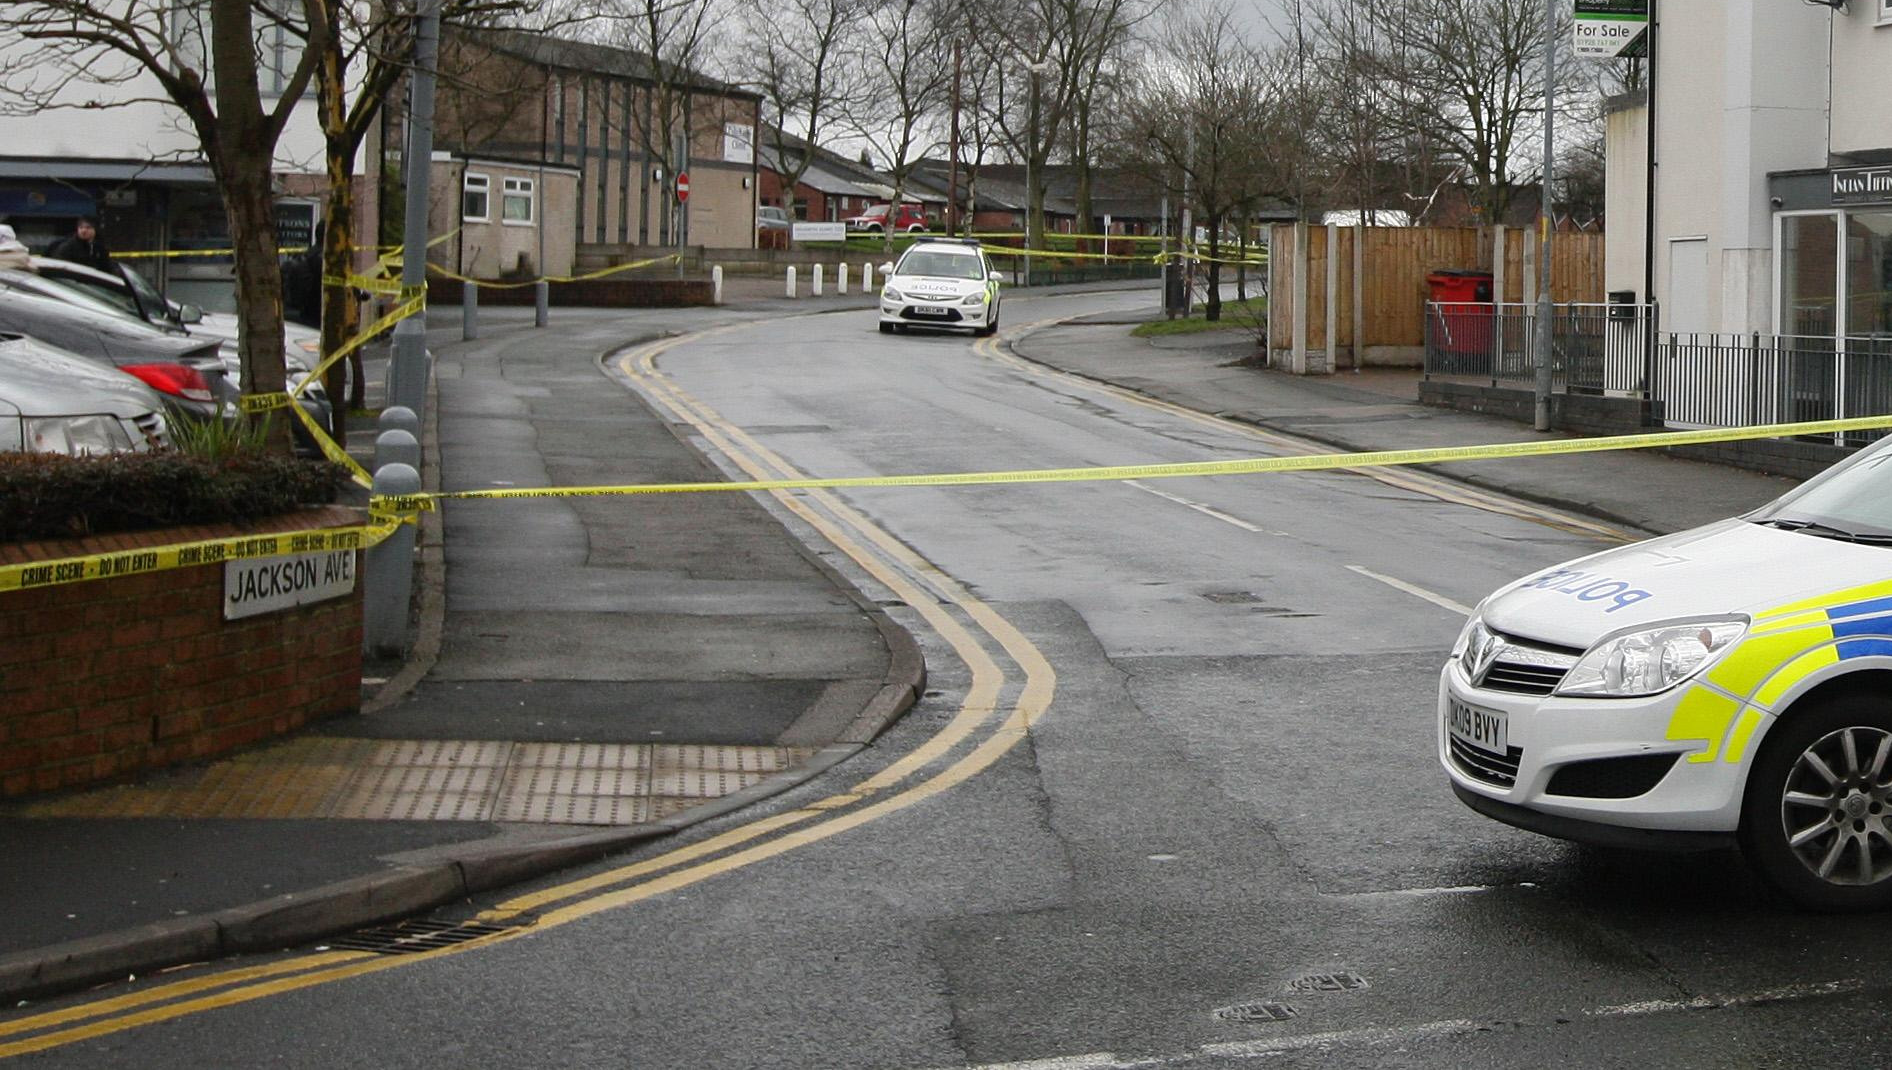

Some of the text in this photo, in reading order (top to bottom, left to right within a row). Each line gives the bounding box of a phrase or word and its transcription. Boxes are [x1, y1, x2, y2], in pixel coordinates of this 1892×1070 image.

[1577, 24, 1630, 37] For Sale
[21, 552, 158, 588] CRIME SCENE DO NOT ENTER
[178, 547, 202, 565] CRIME
[203, 544, 225, 562] SCENE
[246, 540, 258, 556] NOT
[230, 557, 317, 603] JACKSON
[1474, 711, 1500, 747] BVY
